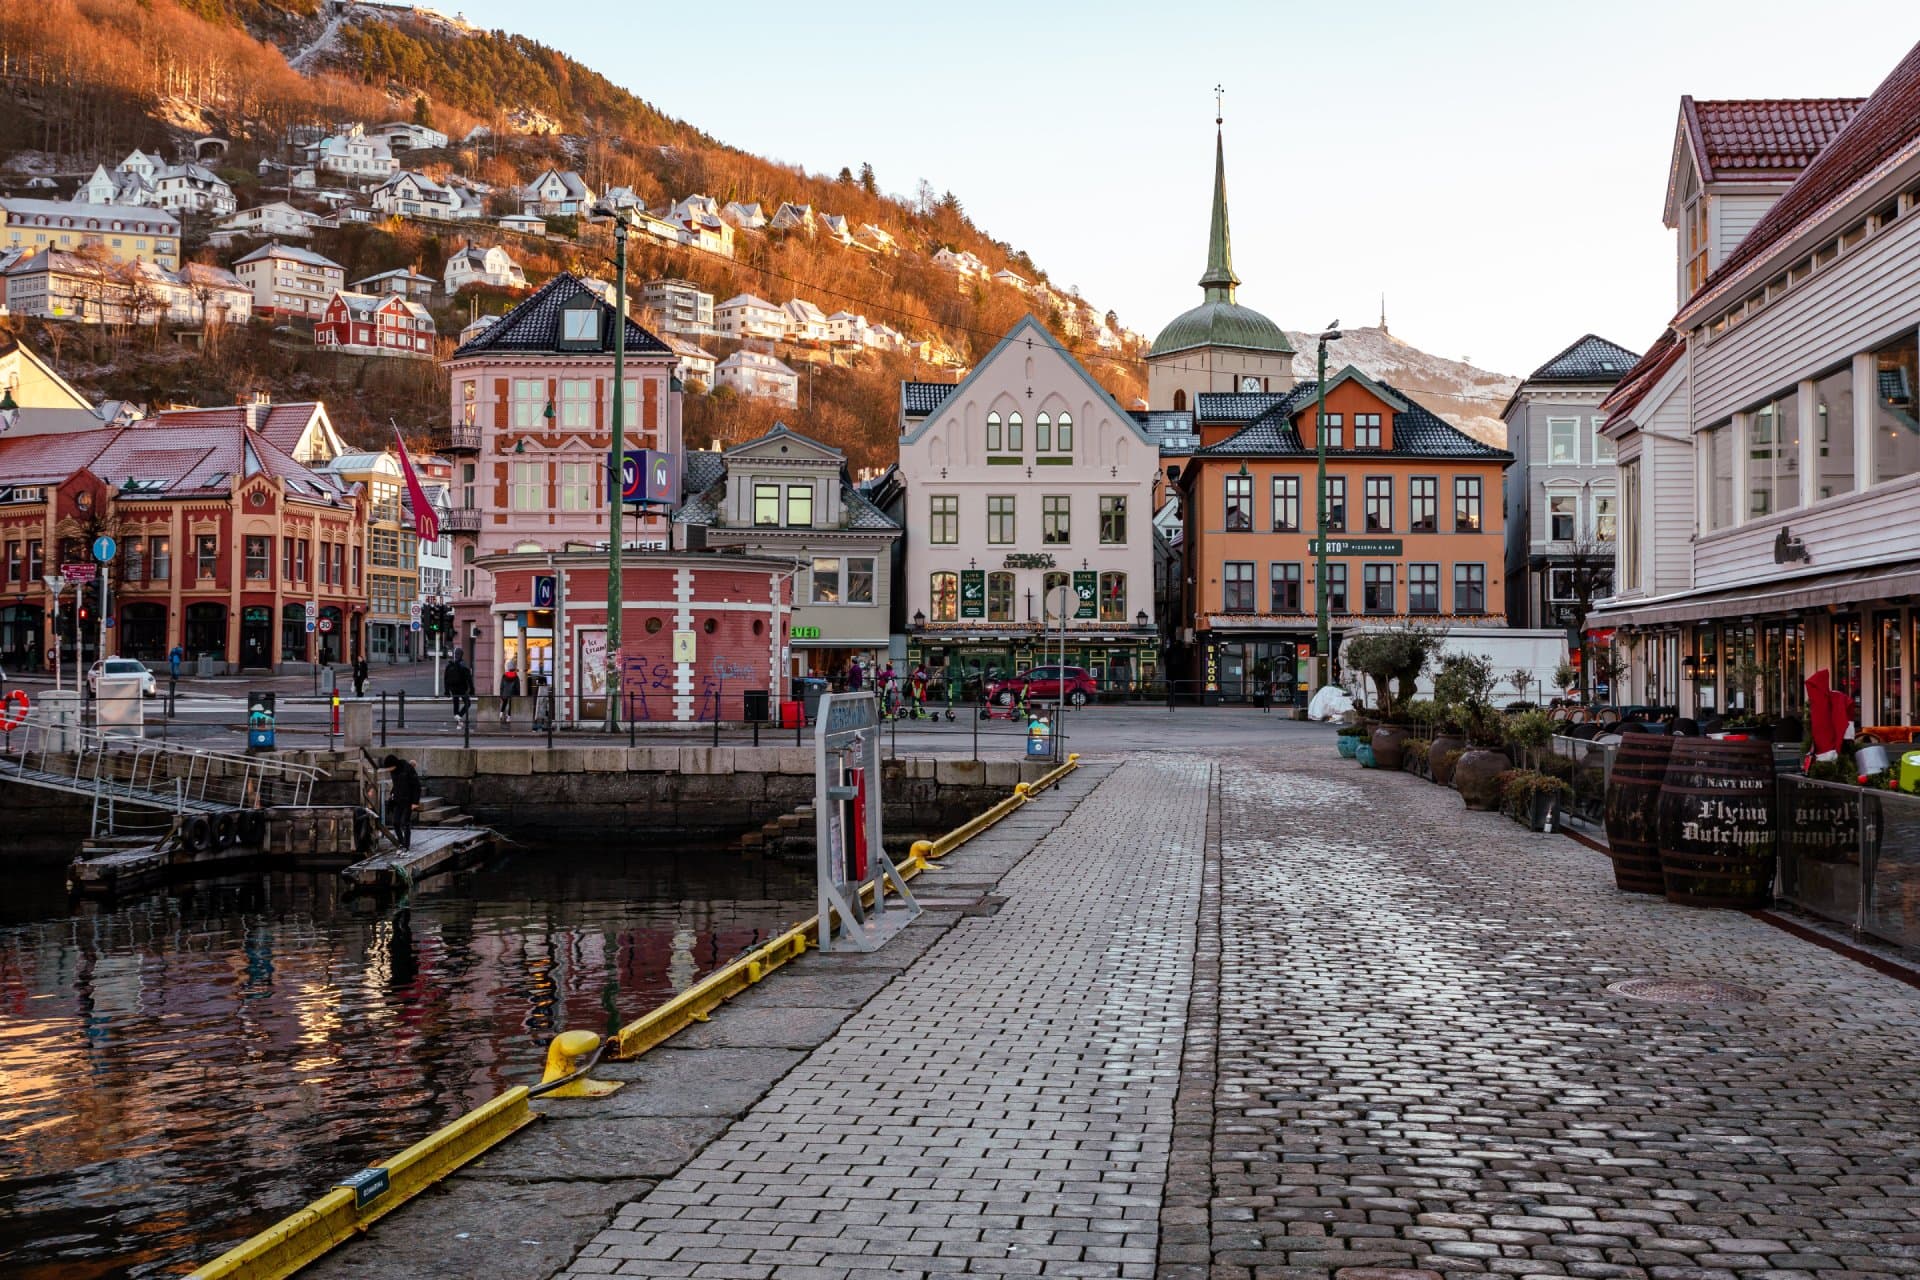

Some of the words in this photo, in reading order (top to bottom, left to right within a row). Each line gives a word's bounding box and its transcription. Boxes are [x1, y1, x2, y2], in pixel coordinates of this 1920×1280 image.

[656, 469, 666, 485] N
[542, 585, 550, 598] N
[1207, 645, 1216, 682] BINGO
[1707, 778, 1736, 789] NAVY
[1740, 779, 1763, 789] RUM
[1698, 801, 1767, 824] Flying
